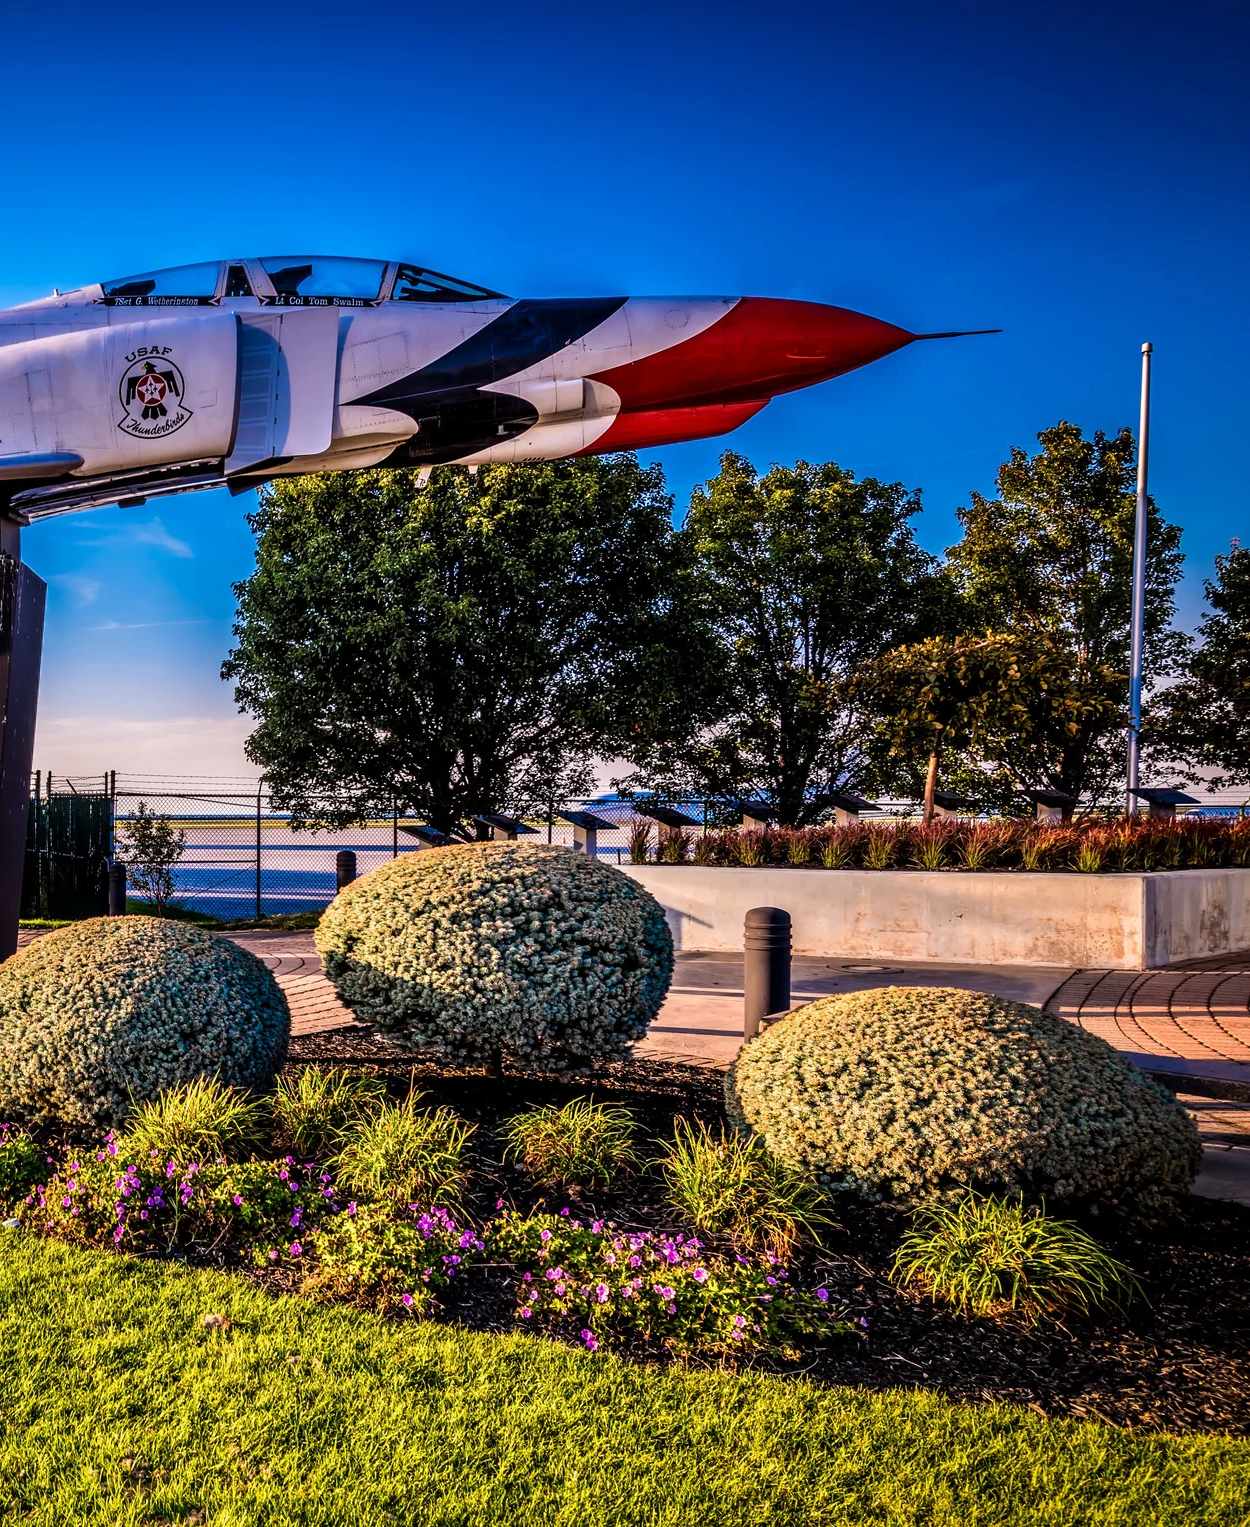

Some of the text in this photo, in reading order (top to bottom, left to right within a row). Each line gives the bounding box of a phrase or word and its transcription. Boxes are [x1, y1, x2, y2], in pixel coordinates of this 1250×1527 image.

[135, 297, 143, 306] G.
[148, 297, 199, 306] Wetherington
[275, 296, 285, 305] Lt
[289, 296, 304, 305] Col
[309, 296, 328, 306] Tom
[124, 345, 173, 363] USAF
[126, 411, 185, 435] Thunderbirds
